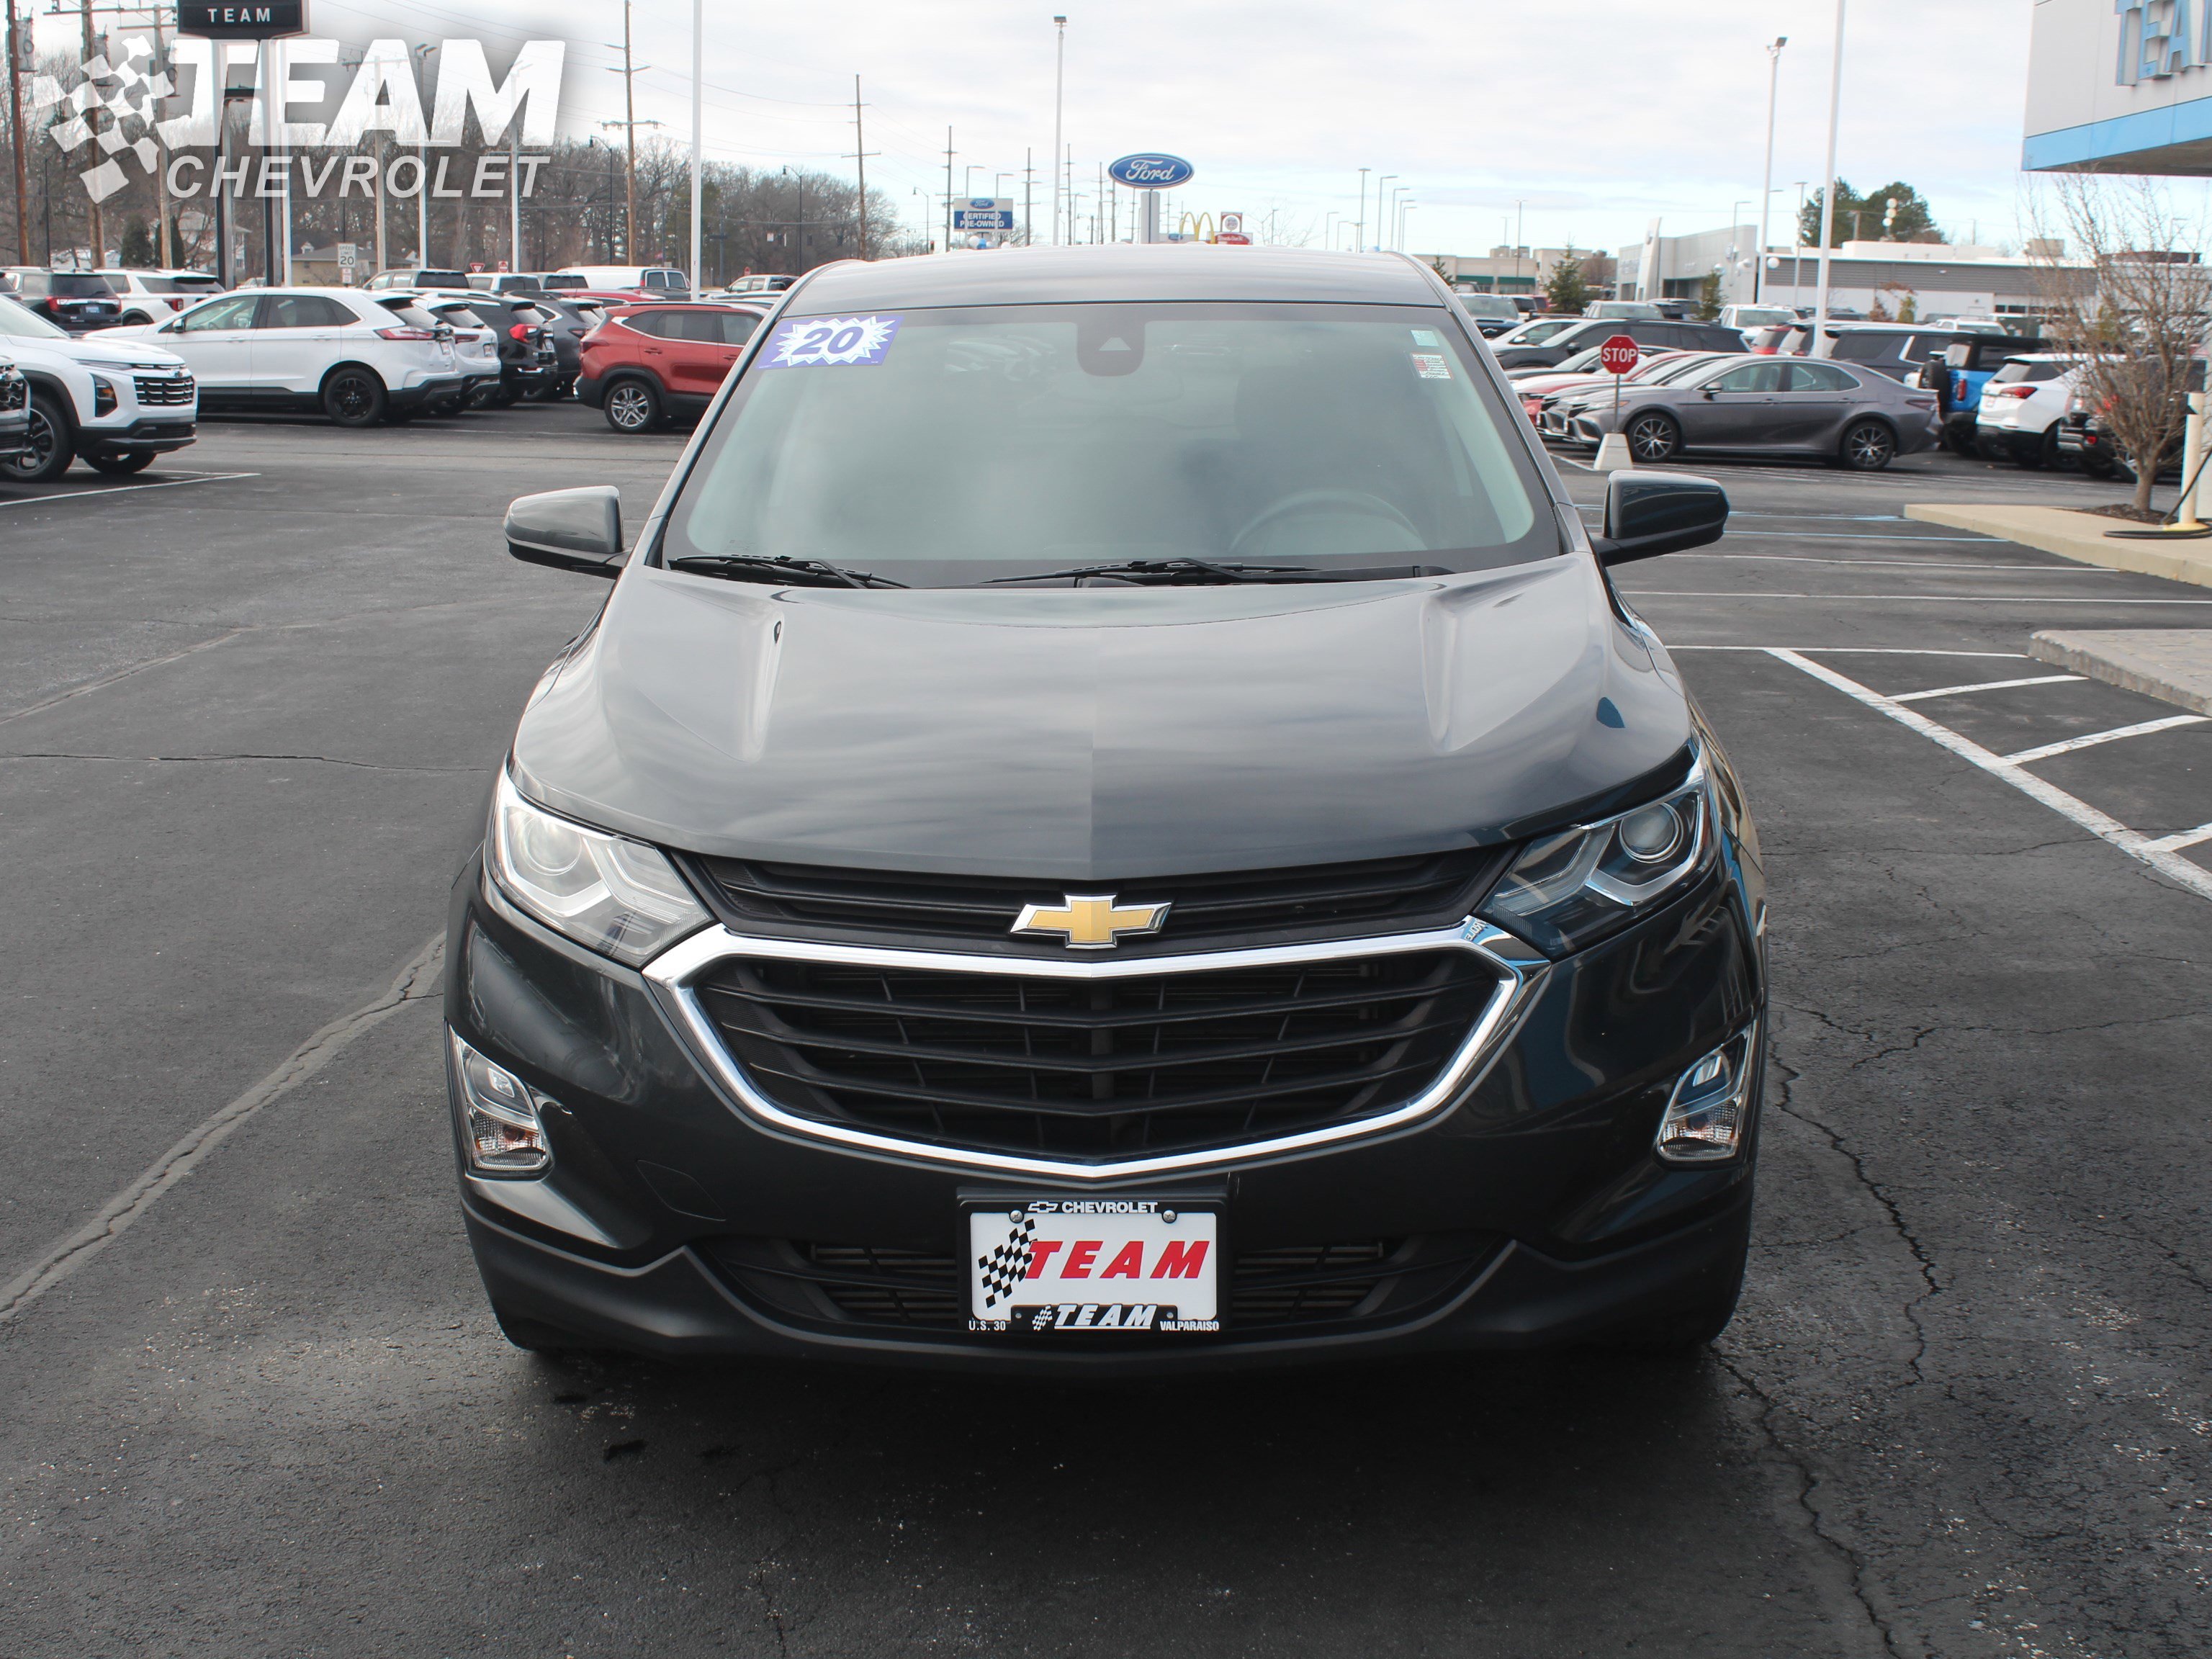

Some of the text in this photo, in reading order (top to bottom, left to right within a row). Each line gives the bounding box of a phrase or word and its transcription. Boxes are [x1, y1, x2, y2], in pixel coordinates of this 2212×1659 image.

[208, 8, 271, 23] TEAM
[2114, 0, 2212, 86] TEA
[1125, 159, 1175, 180] Ford
[340, 256, 354, 265] 20
[791, 326, 864, 355] 20
[1602, 347, 1637, 363] STOP
[1061, 1202, 1158, 1214] CHEVROLET
[1025, 1240, 1210, 1280] TEAM
[1054, 1305, 1157, 1327] TEAM
[968, 1320, 1006, 1331] U.S. 30
[1159, 1320, 1220, 1331] VALPARAISO
